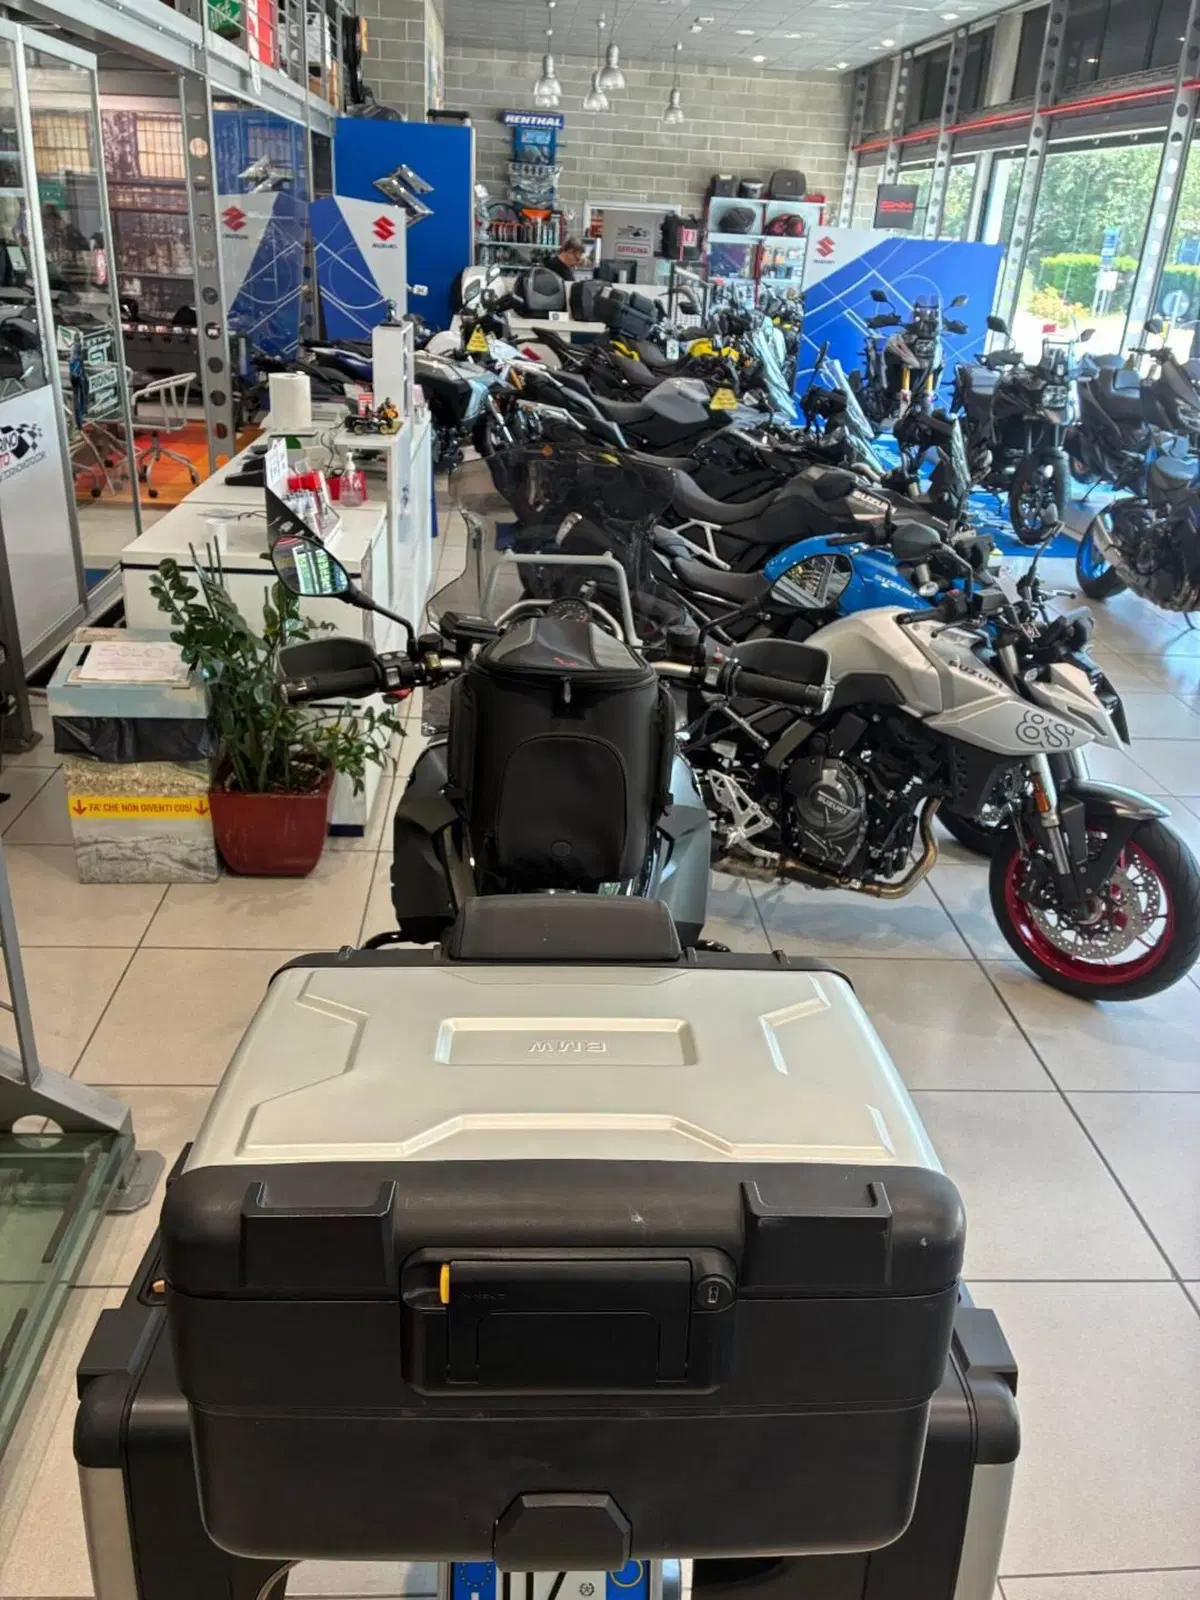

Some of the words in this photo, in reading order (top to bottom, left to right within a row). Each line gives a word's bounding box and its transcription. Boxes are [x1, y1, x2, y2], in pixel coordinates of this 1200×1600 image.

[504, 114, 561, 127] RENTHAL
[851, 489, 898, 515] SUZUKI
[874, 574, 921, 599] SUZUKI
[948, 659, 1004, 689] SUZUKI
[103, 803, 121, 813] CHE
[121, 803, 140, 813] NON
[817, 794, 848, 815] SUZUKI
[527, 1040, 608, 1053] BMW
